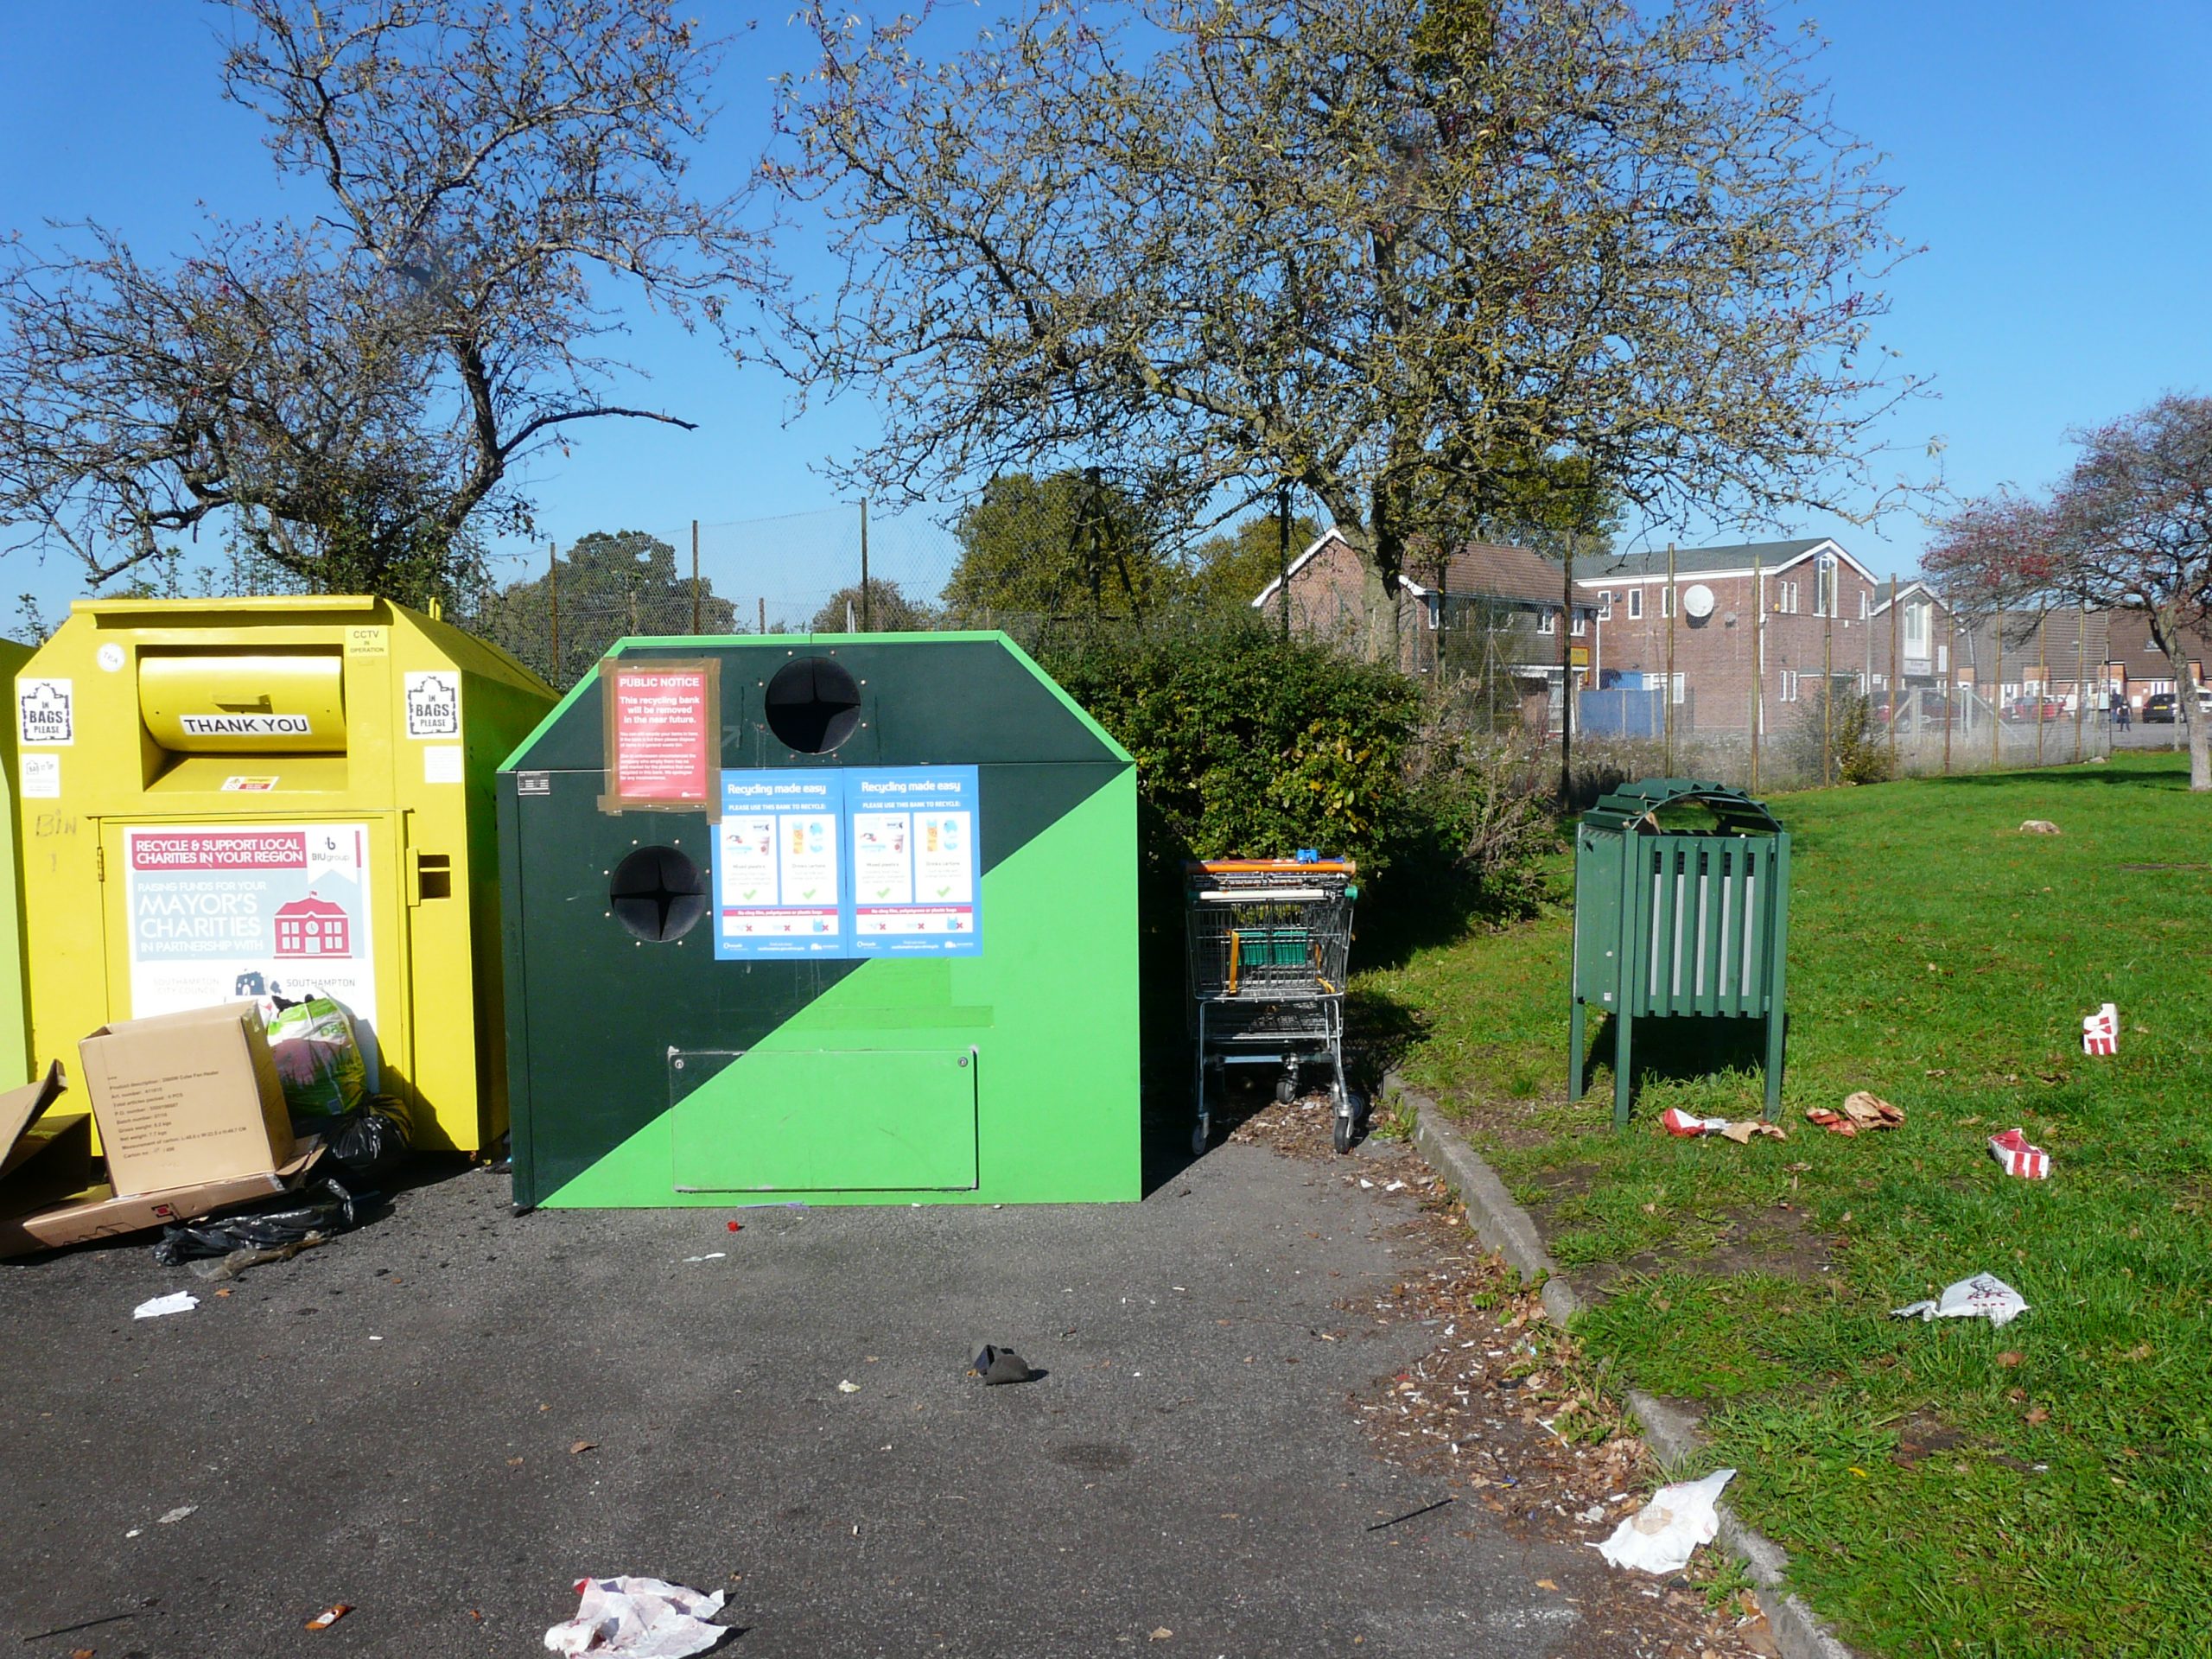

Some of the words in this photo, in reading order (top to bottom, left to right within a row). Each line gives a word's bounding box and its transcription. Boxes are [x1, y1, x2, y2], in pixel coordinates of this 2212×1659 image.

[353, 630, 379, 639] CCTV
[620, 677, 658, 687] PUBLIC
[660, 677, 700, 687] NOTICE
[639, 696, 677, 706] recycling
[416, 704, 450, 716] BAGS
[29, 711, 63, 723] BAGS
[34, 725, 60, 734] PLEASE
[184, 719, 258, 732] THANK
[262, 719, 308, 732] YOU
[728, 784, 772, 796] Recycling
[774, 783, 801, 793] made
[803, 785, 826, 795] easy
[861, 781, 906, 793] Recycling
[908, 781, 935, 791] made
[938, 782, 961, 792] easy
[137, 840, 188, 852] RECYCLE
[191, 840, 200, 851] &
[202, 840, 257, 851] SUPPORT
[260, 839, 300, 850] LOCAL
[137, 852, 197, 864] CHARITIES
[200, 852, 213, 863] IN
[216, 851, 253, 863] YOUR
[254, 850, 303, 862] REGION
[137, 882, 177, 892] RAISING
[180, 882, 213, 892] FUNDS
[216, 881, 236, 891] FOR
[238, 881, 267, 891] YOUR
[138, 893, 258, 916] MAYOR'S
[140, 917, 262, 938] CHARITIES
[141, 942, 154, 952] IN
[156, 940, 232, 951] PARTNERSHIP
[233, 939, 264, 950] WITH
